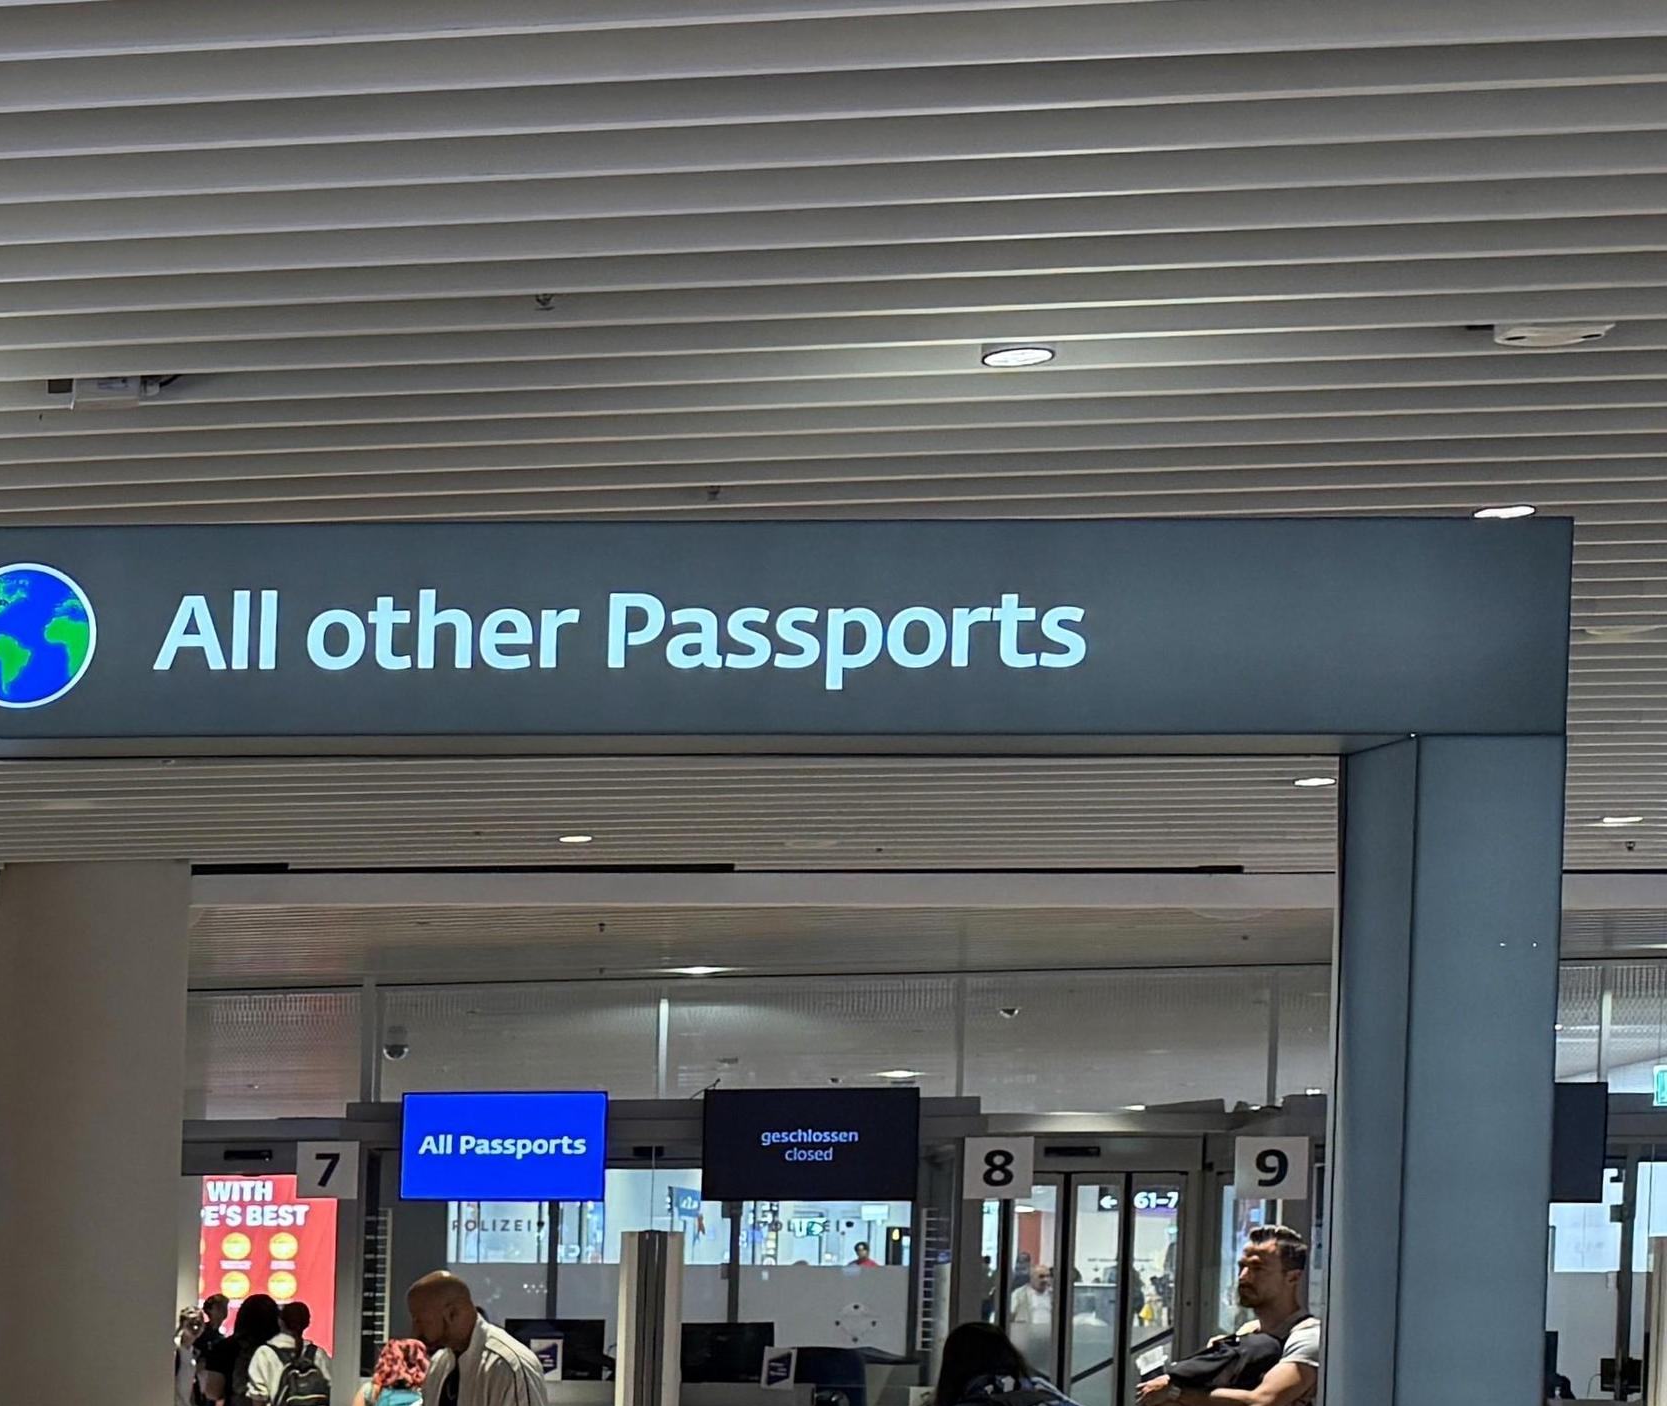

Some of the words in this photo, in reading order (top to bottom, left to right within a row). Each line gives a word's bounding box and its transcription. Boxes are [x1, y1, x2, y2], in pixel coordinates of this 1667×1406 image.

[153, 589, 279, 671] All
[306, 589, 581, 671] other
[607, 592, 1087, 691] Passports
[418, 1134, 453, 1155] All
[459, 1135, 587, 1160] Passports
[760, 1129, 859, 1146] geschlossen
[784, 1147, 833, 1162] closed
[315, 1153, 340, 1187] 7
[982, 1149, 1015, 1187] 8
[1254, 1149, 1290, 1187] 9
[206, 1180, 273, 1202] WITH
[246, 1204, 310, 1226] BEST
